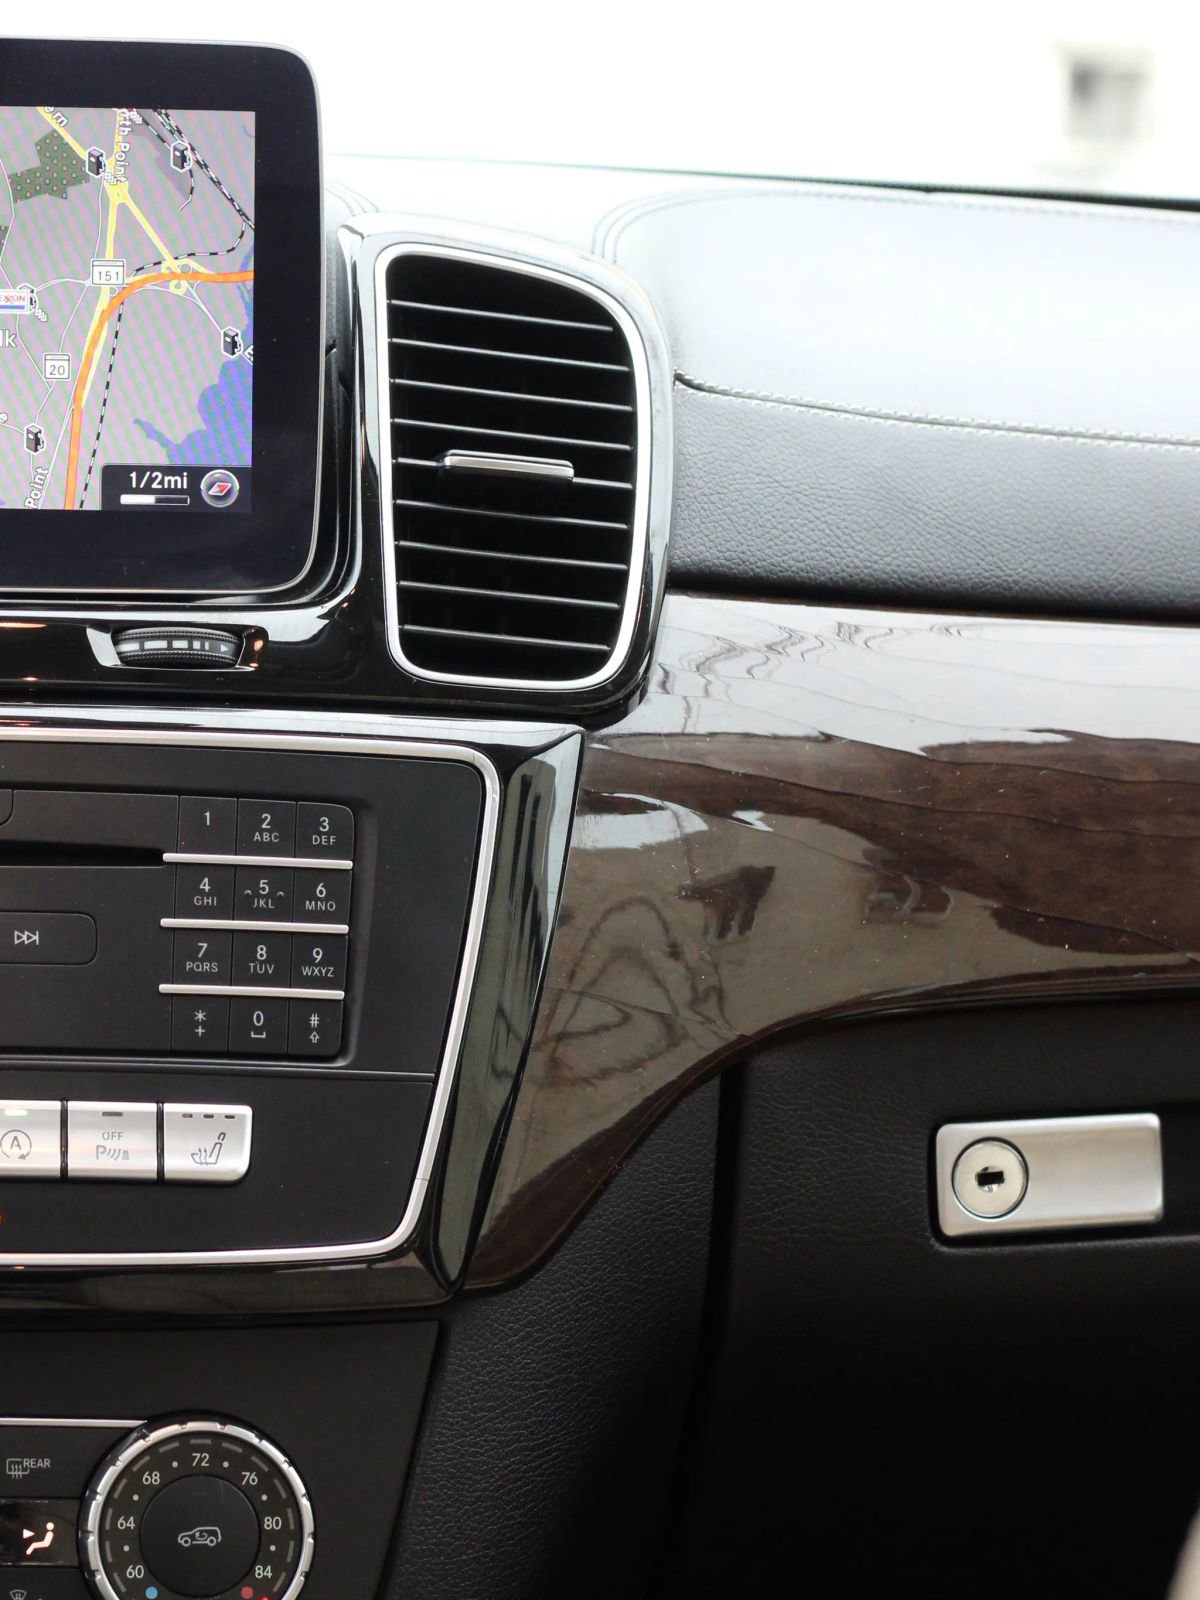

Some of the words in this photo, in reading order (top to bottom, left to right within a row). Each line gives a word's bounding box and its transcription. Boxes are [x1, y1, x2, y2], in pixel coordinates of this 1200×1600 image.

[115, 142, 130, 182] Point
[97, 270, 121, 283] 151
[48, 364, 66, 377] 20
[24, 467, 49, 509] Point
[129, 471, 188, 490] 1/2mi
[204, 811, 212, 826] 1
[261, 813, 272, 829] 2
[319, 817, 330, 832] 3
[253, 832, 280, 843] ABC
[312, 835, 337, 846] DEF
[199, 877, 212, 892] 4
[258, 880, 269, 895] 5
[316, 883, 327, 898] 6
[193, 896, 217, 907] GHI
[252, 898, 276, 909] JKL
[305, 901, 337, 912] MNO
[197, 943, 208, 958] 7
[256, 945, 267, 960] 8
[312, 948, 323, 963] 9
[186, 962, 219, 973] PQRS
[249, 963, 275, 974] TUV
[301, 966, 335, 978] WXYZ
[253, 1011, 264, 1026] 0
[10, 1136, 21, 1150] A
[102, 1131, 124, 1141] OFF
[23, 1458, 52, 1469] REAR
[191, 1453, 210, 1467] 72
[142, 1471, 161, 1486] 68
[241, 1471, 259, 1486] 76
[117, 1516, 136, 1531] 64
[264, 1516, 282, 1531] 80
[126, 1565, 145, 1579] 60
[254, 1565, 273, 1579] 84
